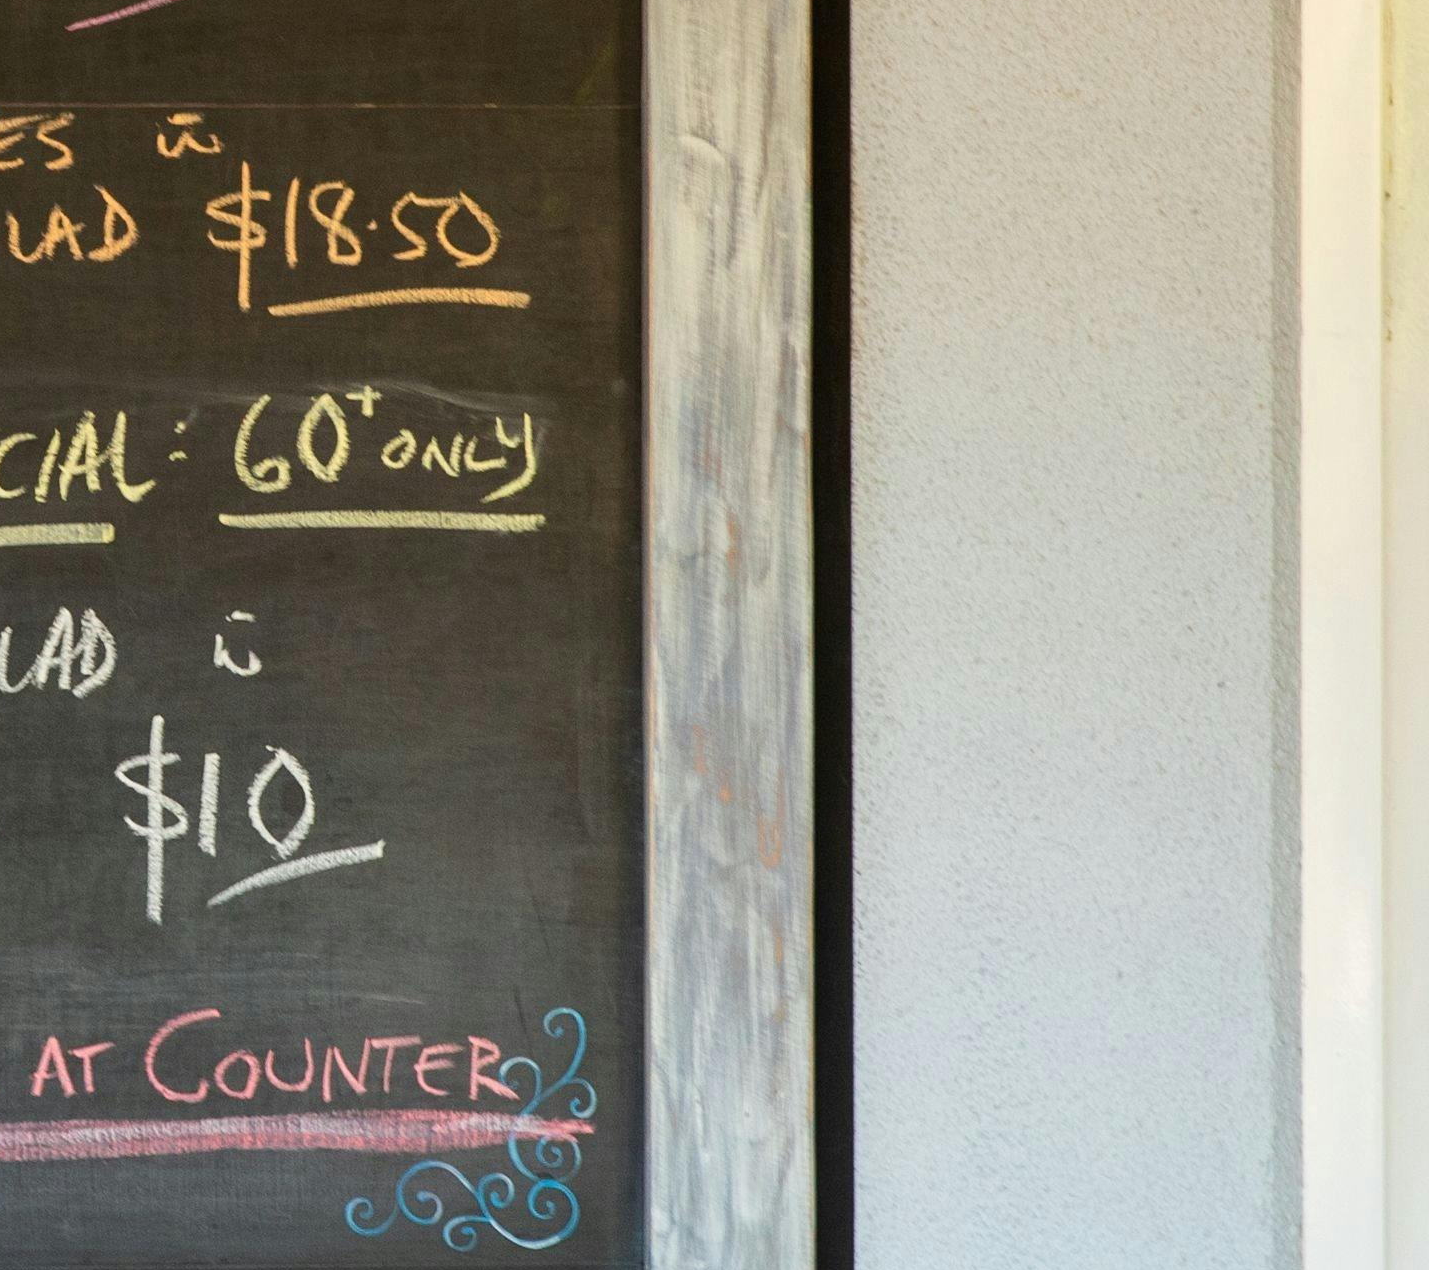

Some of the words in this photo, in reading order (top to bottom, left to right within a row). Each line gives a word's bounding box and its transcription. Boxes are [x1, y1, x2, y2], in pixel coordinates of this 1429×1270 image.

[204, 161, 503, 311] $18.50
[114, 714, 317, 925] $10
[31, 1035, 109, 1097] AT
[144, 1007, 520, 1104] COUNTER
